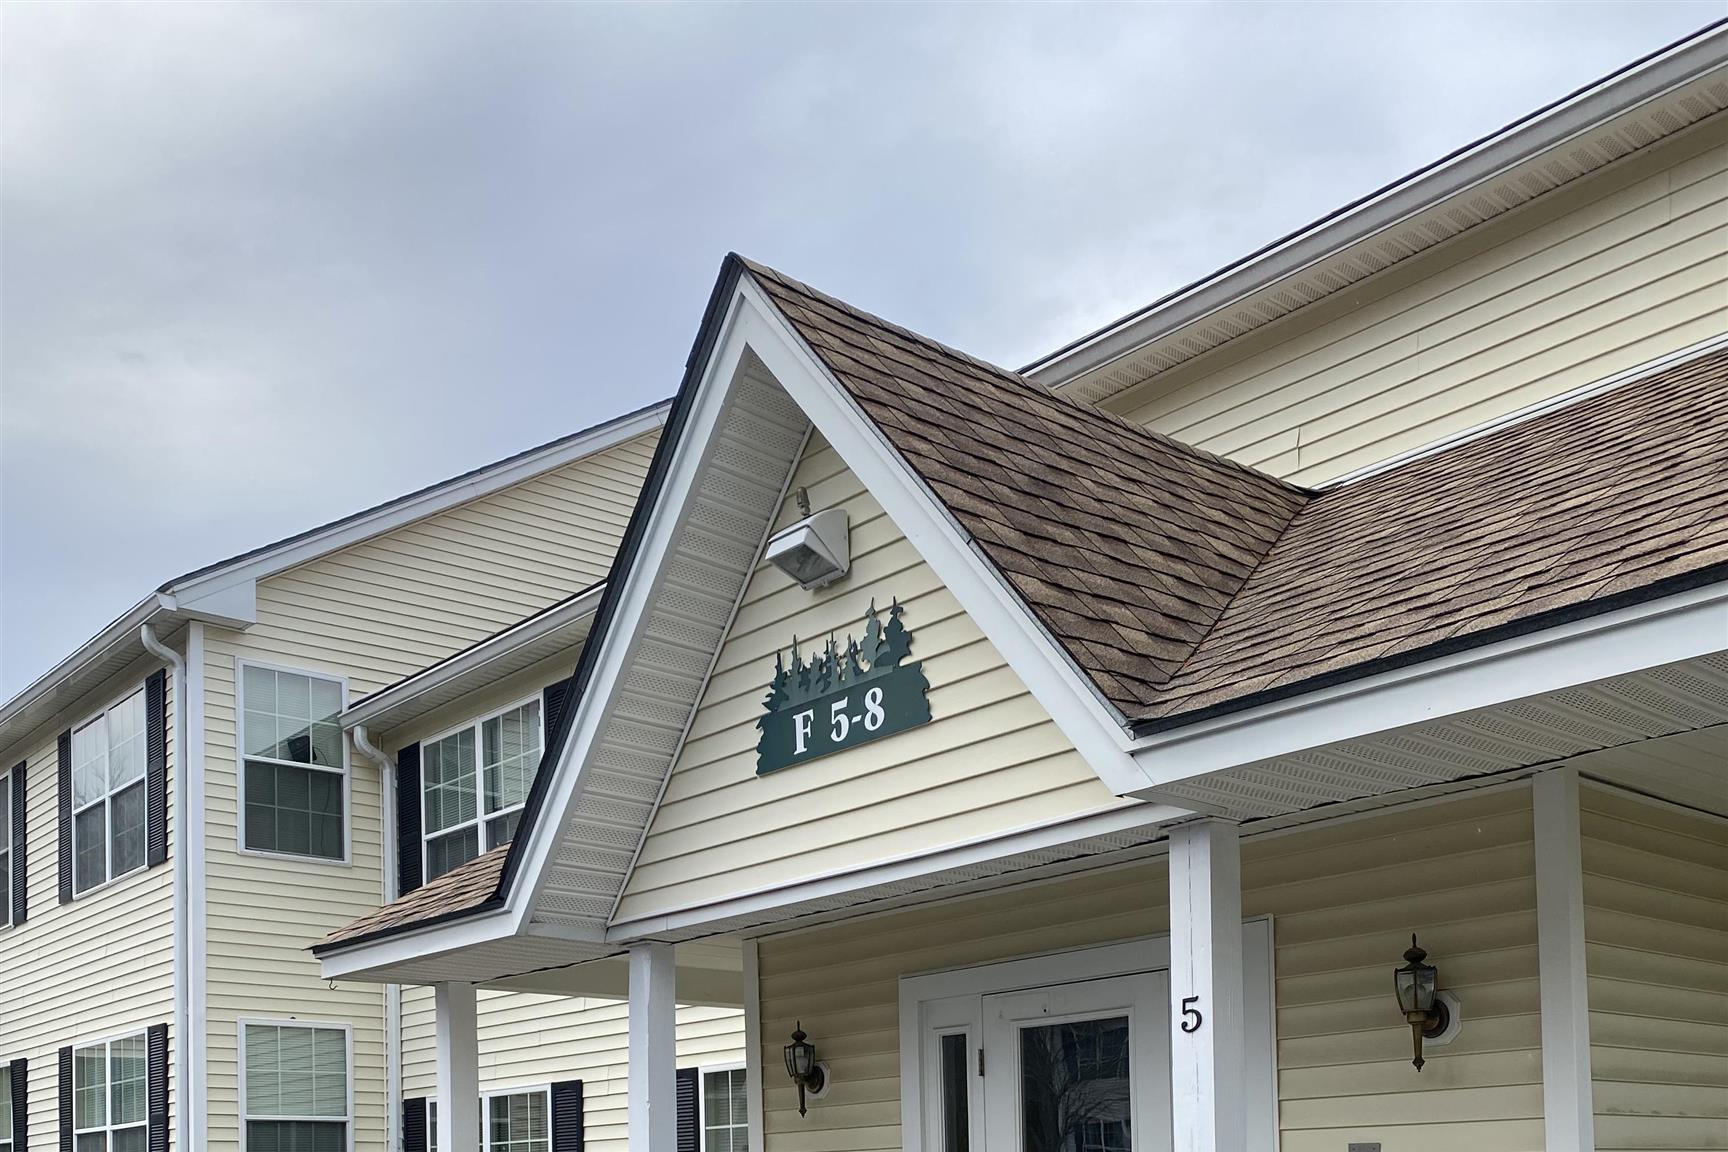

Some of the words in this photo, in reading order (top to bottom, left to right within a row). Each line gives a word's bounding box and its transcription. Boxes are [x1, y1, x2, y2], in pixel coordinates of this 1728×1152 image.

[792, 709, 814, 755] F
[830, 687, 885, 742] 5-8
[1181, 995, 1203, 1033] 5
